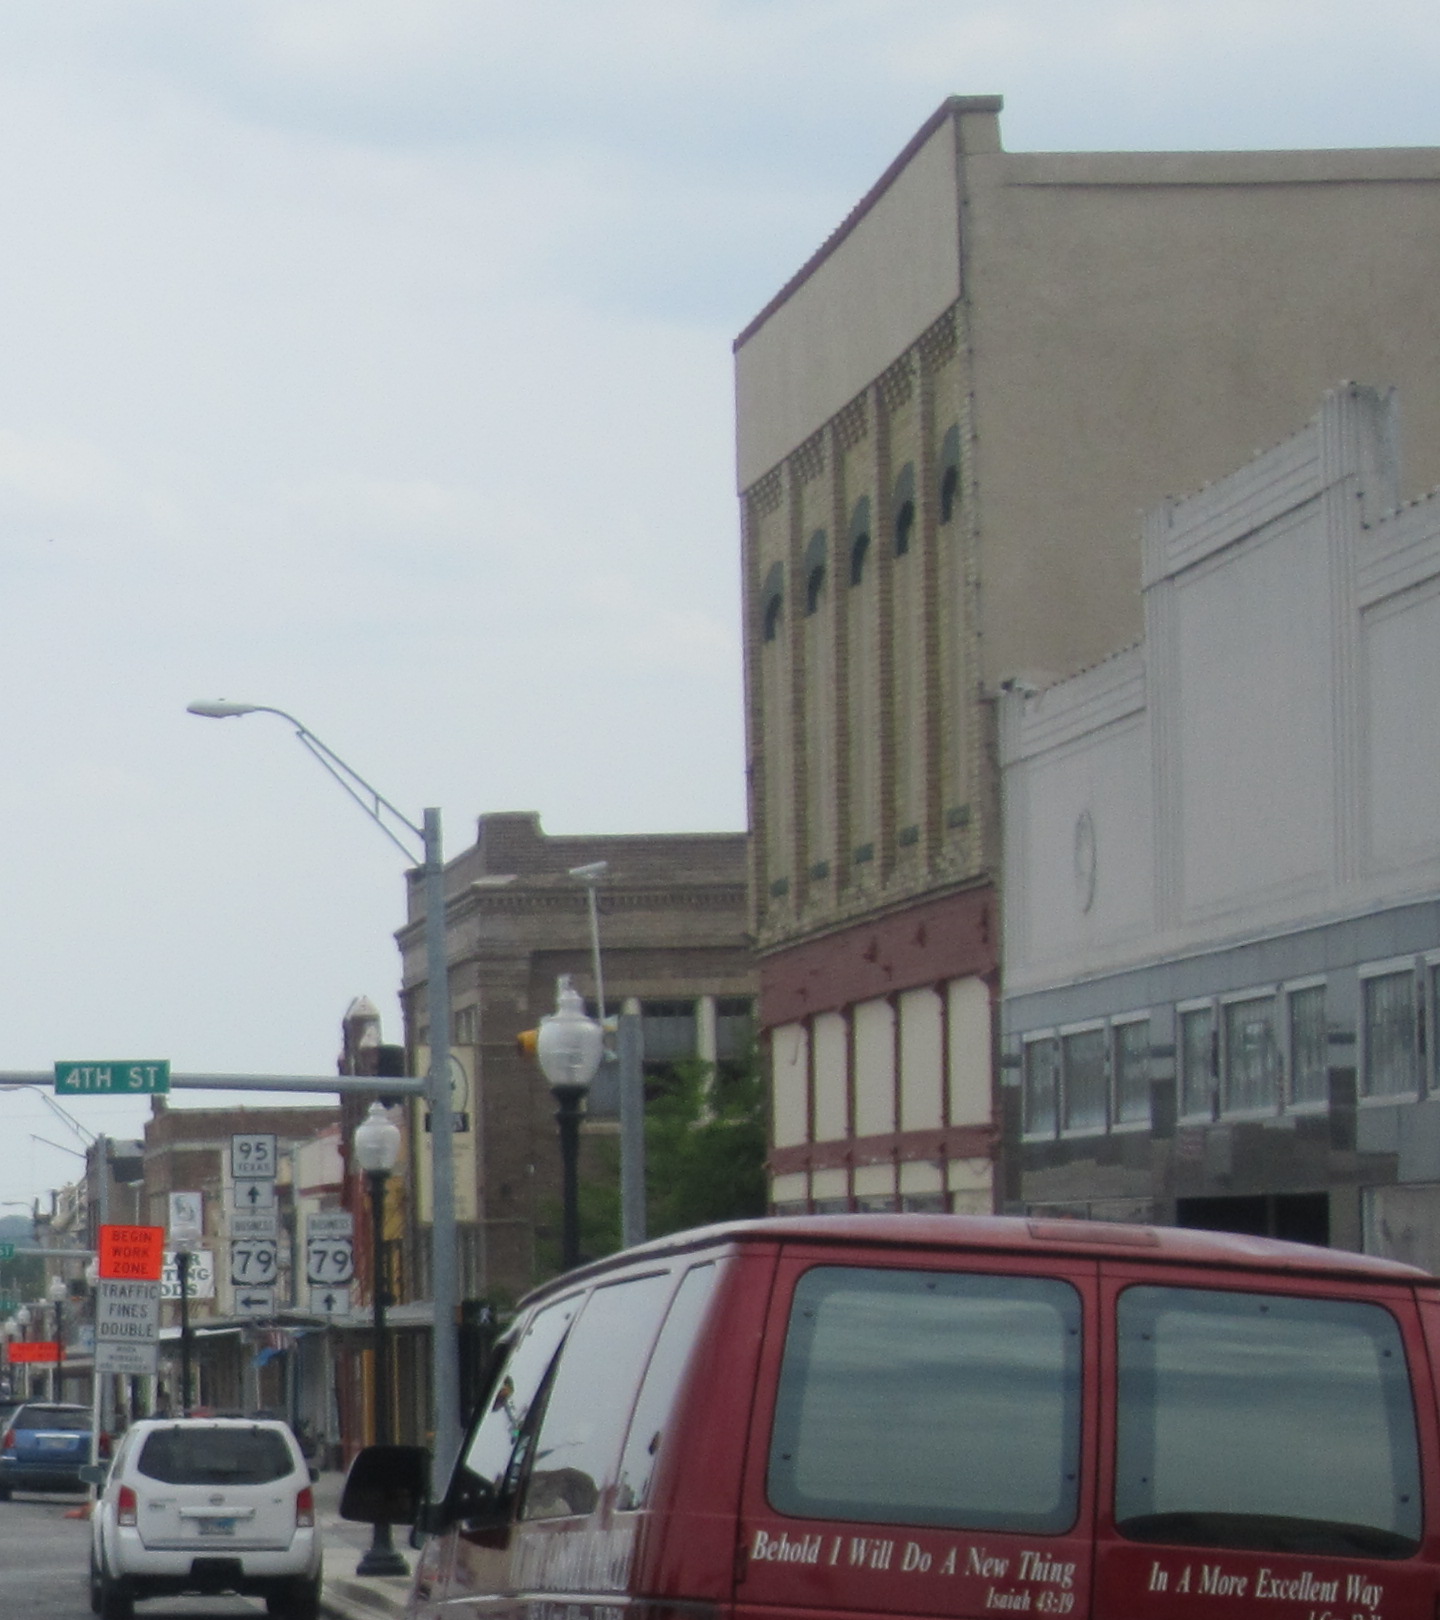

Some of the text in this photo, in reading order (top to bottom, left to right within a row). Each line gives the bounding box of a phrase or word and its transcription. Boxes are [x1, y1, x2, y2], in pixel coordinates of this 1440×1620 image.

[66, 1066, 158, 1088] 4TH ST
[239, 1143, 268, 1160] 95
[112, 1231, 152, 1243] BEGIN
[112, 1247, 149, 1258] WORK
[113, 1263, 148, 1275] ZONE
[237, 1251, 272, 1275] 79
[314, 1251, 349, 1274] 79
[104, 1285, 157, 1300] TRAFFIC
[109, 1303, 148, 1318] FINES
[101, 1323, 154, 1338] DOUBLE
[751, 1530, 1076, 1588] Behold I Will Do A New Thing
[1148, 1561, 1384, 1611] In A More Excellent Way
[986, 1587, 1074, 1614] Isaiah 43:19
